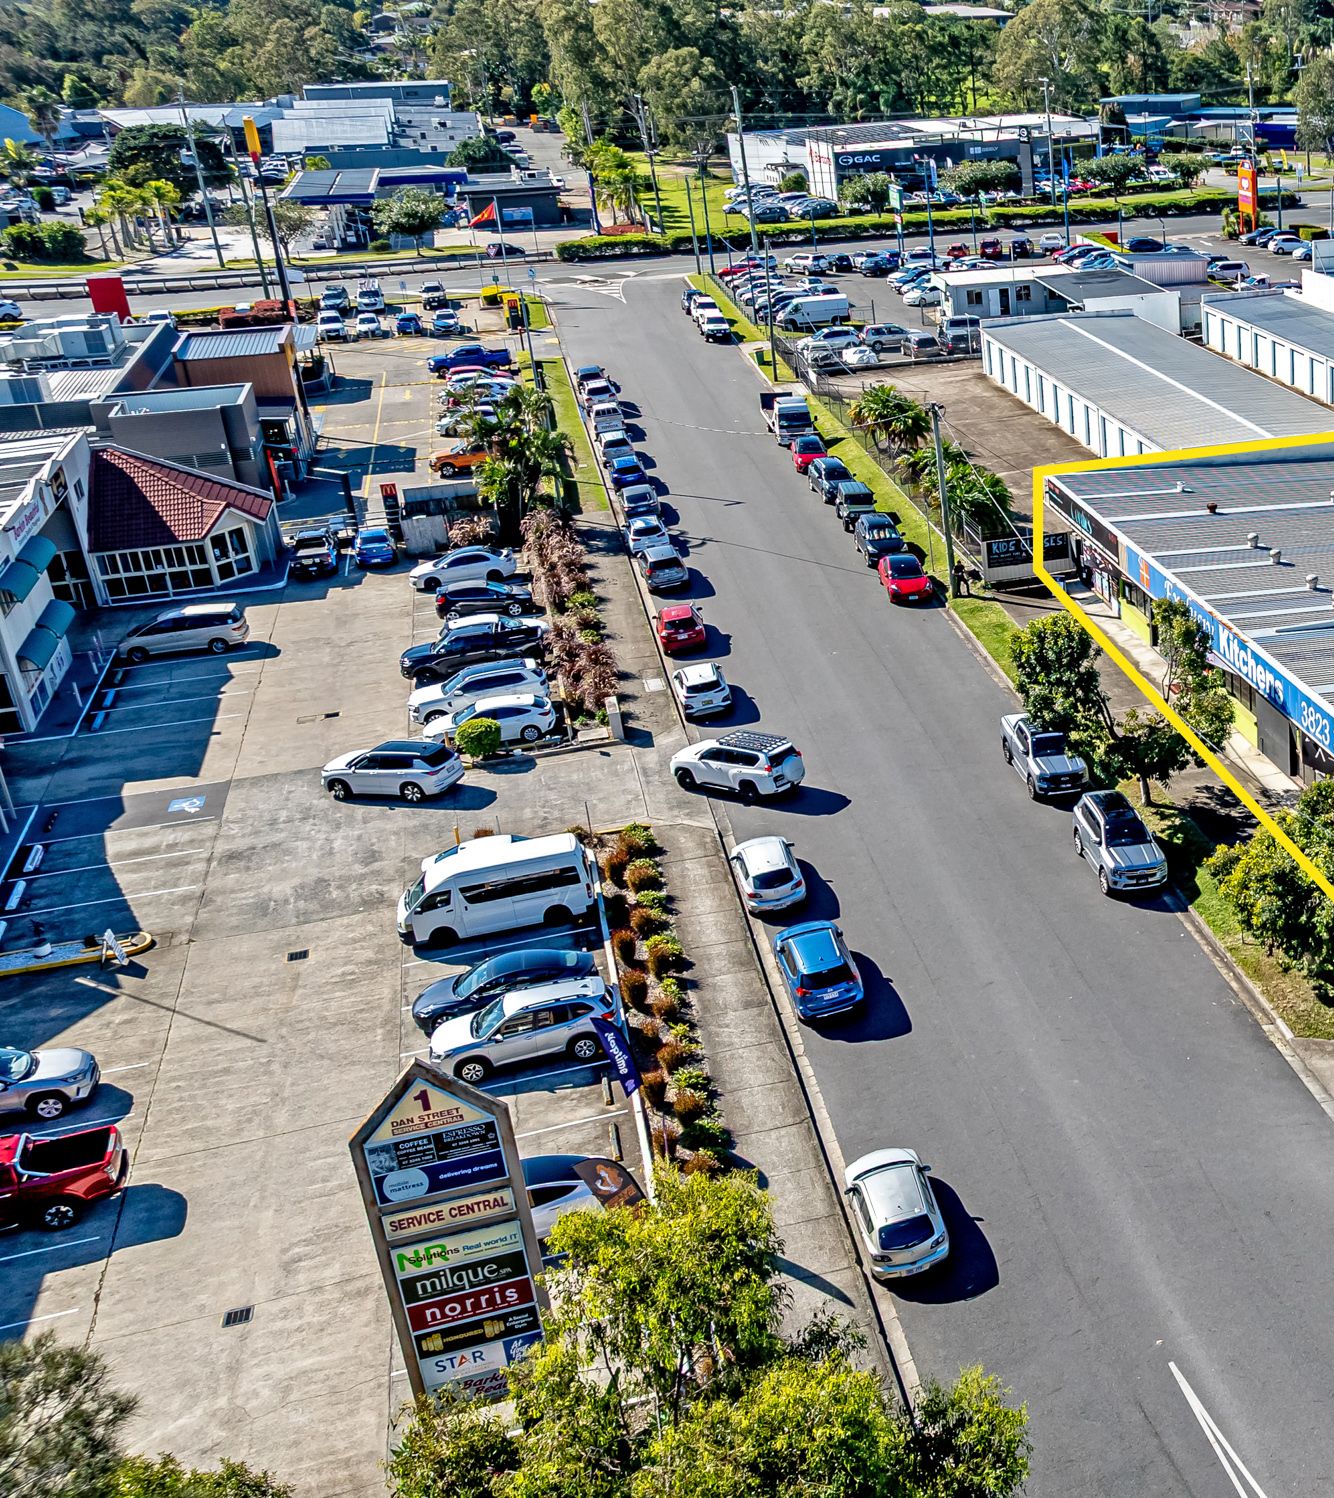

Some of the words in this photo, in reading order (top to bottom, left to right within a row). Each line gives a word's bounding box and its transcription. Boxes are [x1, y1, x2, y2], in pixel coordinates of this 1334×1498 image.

[854, 154, 881, 165] GAC
[991, 540, 1016, 554] KIDS
[1020, 533, 1067, 551] CLSES!
[1218, 623, 1284, 706] Kitchens
[1300, 700, 1331, 747] 3823
[604, 1031, 629, 1075] Naptime
[413, 1088, 432, 1113] 1
[391, 1115, 418, 1129] DAN
[418, 1106, 461, 1123] STREET
[393, 1122, 426, 1136] SERVICE
[426, 1114, 463, 1129] CENTRAL
[442, 1124, 486, 1139] ESPRESSO
[397, 1148, 416, 1156] COFFEE
[399, 1138, 429, 1150] COFFEE
[438, 1168, 472, 1180] delivering
[472, 1162, 498, 1172] dreams
[389, 1182, 425, 1194] mattress
[389, 1209, 445, 1232] SERVICE
[448, 1195, 509, 1219] CENTRAL
[462, 1241, 482, 1252] Real
[483, 1235, 508, 1247] world
[508, 1232, 518, 1241] IT
[408, 1246, 460, 1265] Solutions
[416, 1262, 499, 1295] milque
[424, 1287, 519, 1322] norris
[442, 1328, 484, 1343] HONOURED
[434, 1350, 486, 1373] STAR
